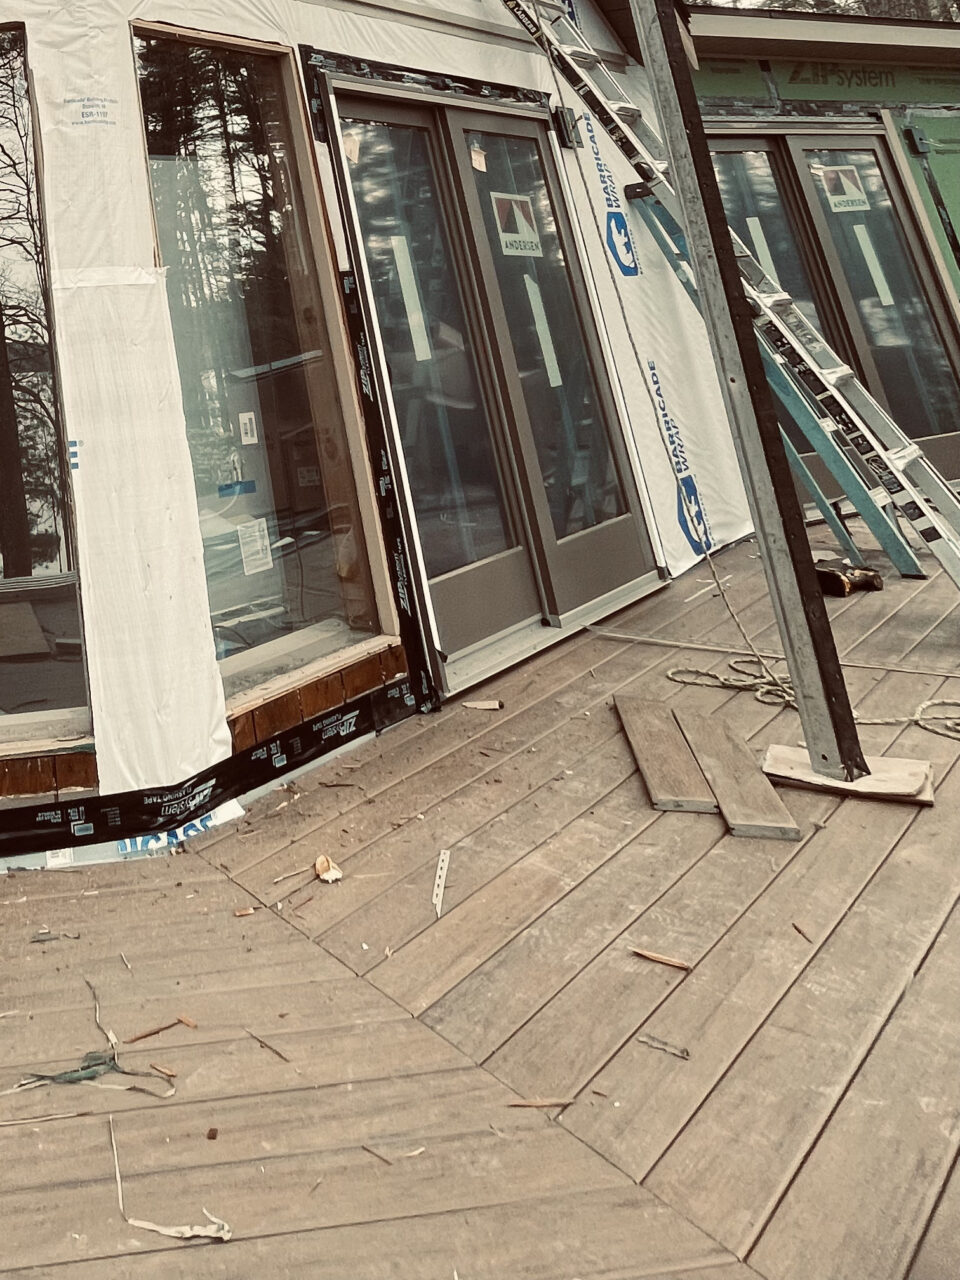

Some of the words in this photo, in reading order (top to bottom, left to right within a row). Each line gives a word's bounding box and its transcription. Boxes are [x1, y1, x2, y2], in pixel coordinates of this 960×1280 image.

[513, 7, 537, 33] LADDERS
[583, 111, 614, 208] BARRICADE
[602, 163, 621, 209] WRAP
[505, 239, 540, 252] ANDERSEN
[647, 359, 683, 474] BARRICADE
[669, 417, 690, 472] WRAP
[143, 795, 162, 804] TAPE
